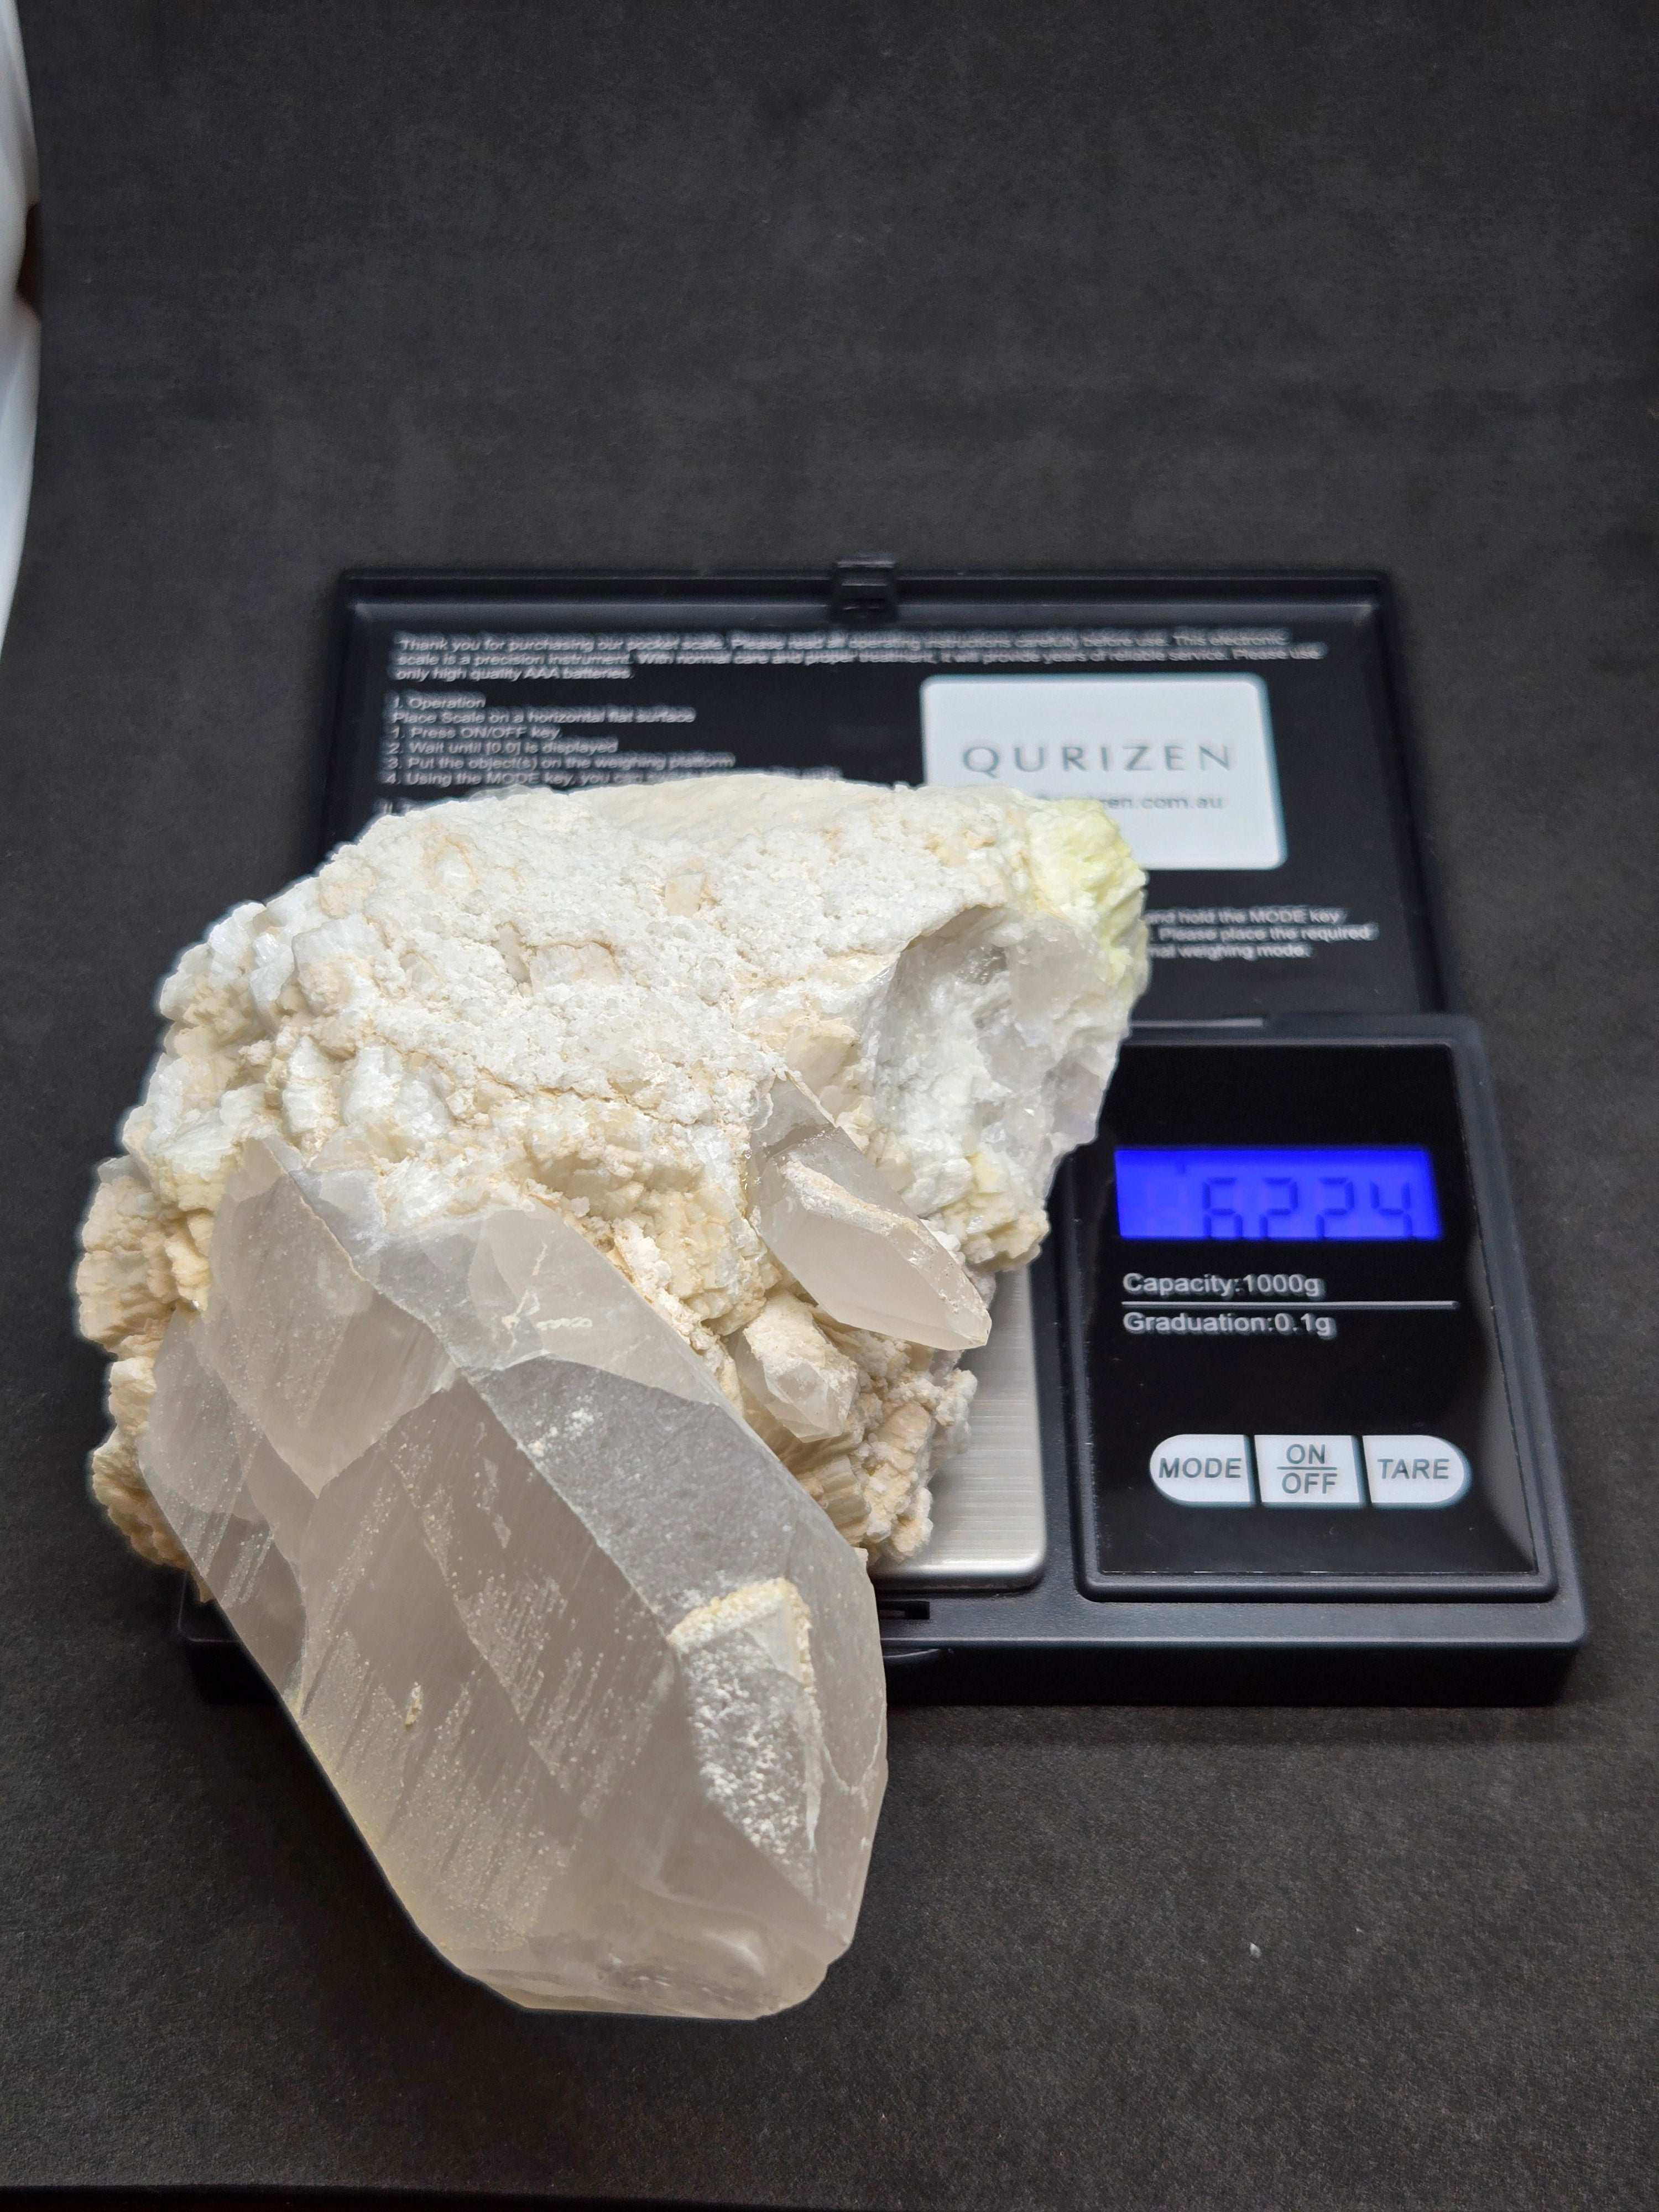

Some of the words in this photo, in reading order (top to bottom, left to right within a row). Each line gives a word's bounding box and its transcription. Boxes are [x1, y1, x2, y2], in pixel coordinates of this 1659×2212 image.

[398, 639, 448, 651] Thank
[451, 639, 481, 653] you
[483, 638, 505, 651] for
[507, 639, 595, 653] purchasing
[848, 638, 921, 651] operating
[1015, 636, 1078, 650] carefully
[1082, 635, 1134, 648] before
[1172, 635, 1207, 647] This
[397, 653, 440, 665] scale
[458, 655, 471, 665] a
[473, 653, 545, 666] precision
[396, 666, 430, 682] only
[432, 666, 467, 682] high
[469, 666, 523, 682] quality
[524, 666, 560, 679] AAA
[407, 695, 486, 711] Operation
[390, 711, 437, 724] Place
[441, 711, 486, 724] Scale
[488, 713, 510, 723] on
[513, 713, 524, 723] a
[527, 709, 606, 723] horizontal
[410, 726, 456, 739] Press
[460, 724, 528, 739] ON/OFF
[409, 742, 445, 754] Wait
[447, 741, 482, 754] until
[524, 742, 539, 754] is
[541, 739, 619, 756] displayed
[407, 757, 435, 769] Put
[438, 757, 465, 769] the
[468, 756, 538, 771] object(s)
[540, 759, 562, 769] on
[565, 755, 592, 769] the
[593, 756, 666, 771] weighing
[960, 742, 1230, 779] QURIZEN
[406, 772, 453, 788] Using
[455, 772, 483, 784] the
[484, 772, 541, 785] MODE
[1177, 908, 1216, 924] hold
[1218, 907, 1248, 924] the
[1249, 907, 1307, 924] MODE
[1159, 926, 1217, 941] Please
[1219, 927, 1267, 943] place
[1269, 926, 1297, 941] the
[1300, 925, 1373, 943] required
[1178, 942, 1255, 961] weighing
[1203, 1177, 1415, 1239] 6224
[1123, 1273, 1326, 1299] Capacity:1000g
[1123, 1312, 1337, 1340] Graduation:0.1g
[1286, 1443, 1326, 1465] ON
[1158, 1457, 1243, 1480] MODE
[1377, 1457, 1451, 1480] TARE
[1281, 1472, 1338, 1495] OFF
